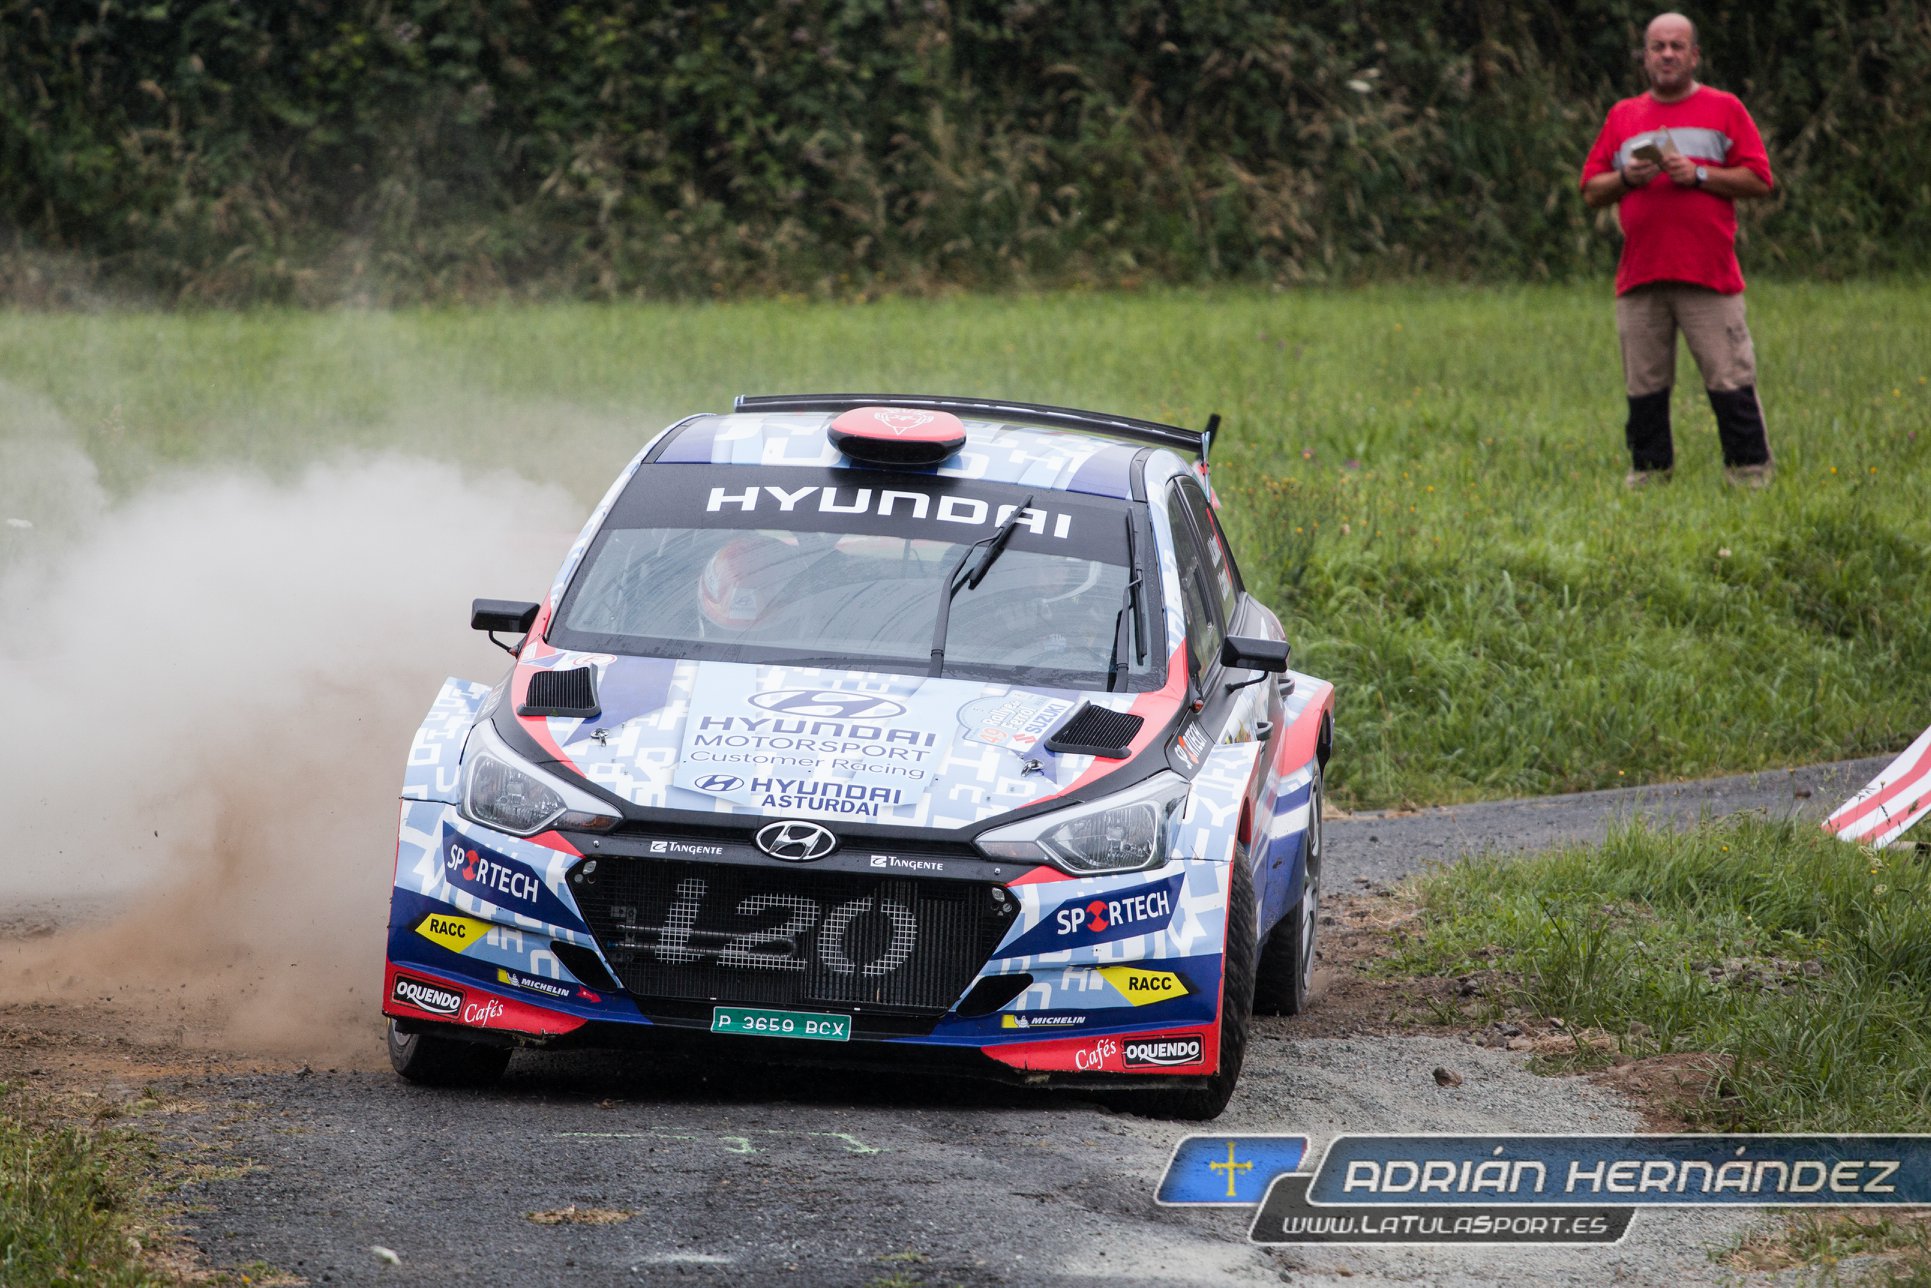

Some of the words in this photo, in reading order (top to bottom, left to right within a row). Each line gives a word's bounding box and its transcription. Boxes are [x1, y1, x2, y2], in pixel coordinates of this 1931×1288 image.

[706, 485, 1071, 539] HYUNDAI
[1025, 703, 1067, 734] SUZUKI
[699, 715, 936, 748] HYUNDAI
[693, 734, 931, 761] MOTORSPORT
[689, 750, 825, 768] Customer
[831, 760, 925, 780] Racing
[749, 777, 902, 805] HYUNDAI
[761, 795, 879, 817] ASTURDAI
[669, 840, 723, 856] TANGENTE
[888, 855, 944, 871] TANGENTE
[428, 918, 467, 939] RACC
[395, 981, 462, 1011] OQUENDO
[520, 977, 570, 998] MICHELIN
[1128, 976, 1173, 991] RACC
[463, 999, 504, 1028] Cafés
[718, 1014, 731, 1028] P
[742, 1016, 794, 1033] 3659
[805, 1020, 845, 1037] BCX
[1031, 1015, 1086, 1025] MICHELIN
[1074, 1038, 1117, 1070] Cafés
[1126, 1041, 1200, 1061] OQUENDO
